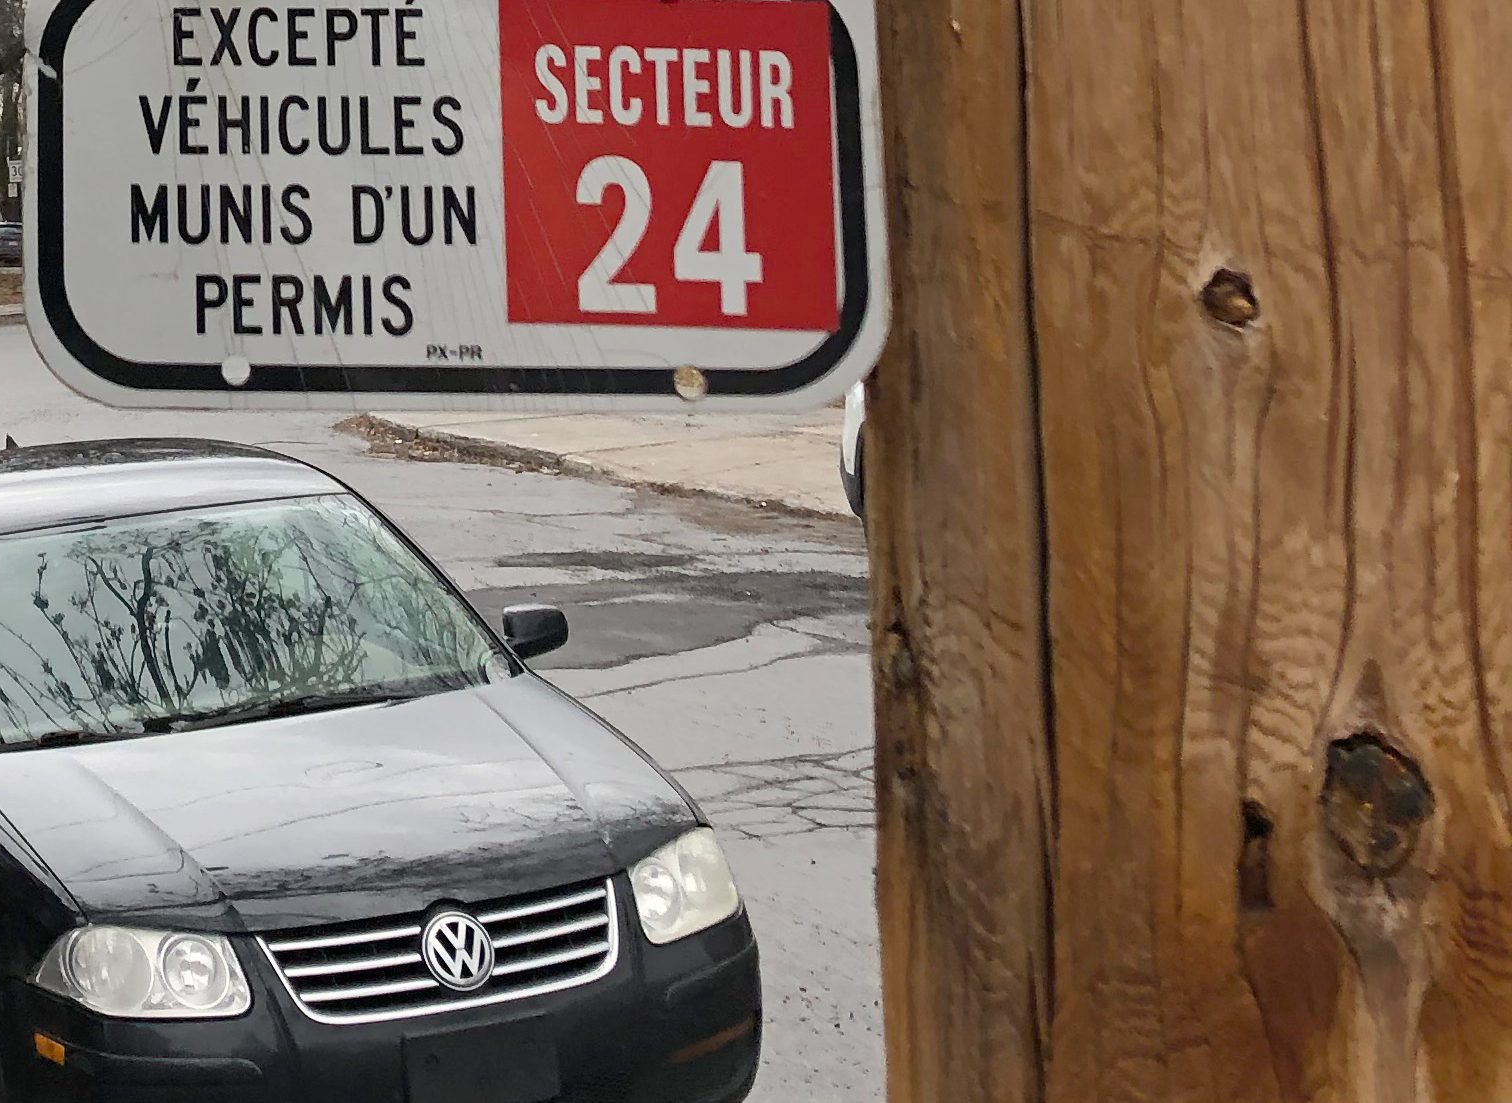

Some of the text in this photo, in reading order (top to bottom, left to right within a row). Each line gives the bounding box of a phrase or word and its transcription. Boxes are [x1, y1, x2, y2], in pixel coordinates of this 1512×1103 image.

[139, 78, 466, 157] VÉHICULES
[533, 42, 795, 131] SECTEUR
[130, 182, 478, 246] MUNIS D'UN
[574, 154, 764, 317] 24
[195, 273, 415, 337] PERMIS
[426, 343, 483, 361] PX-PR
